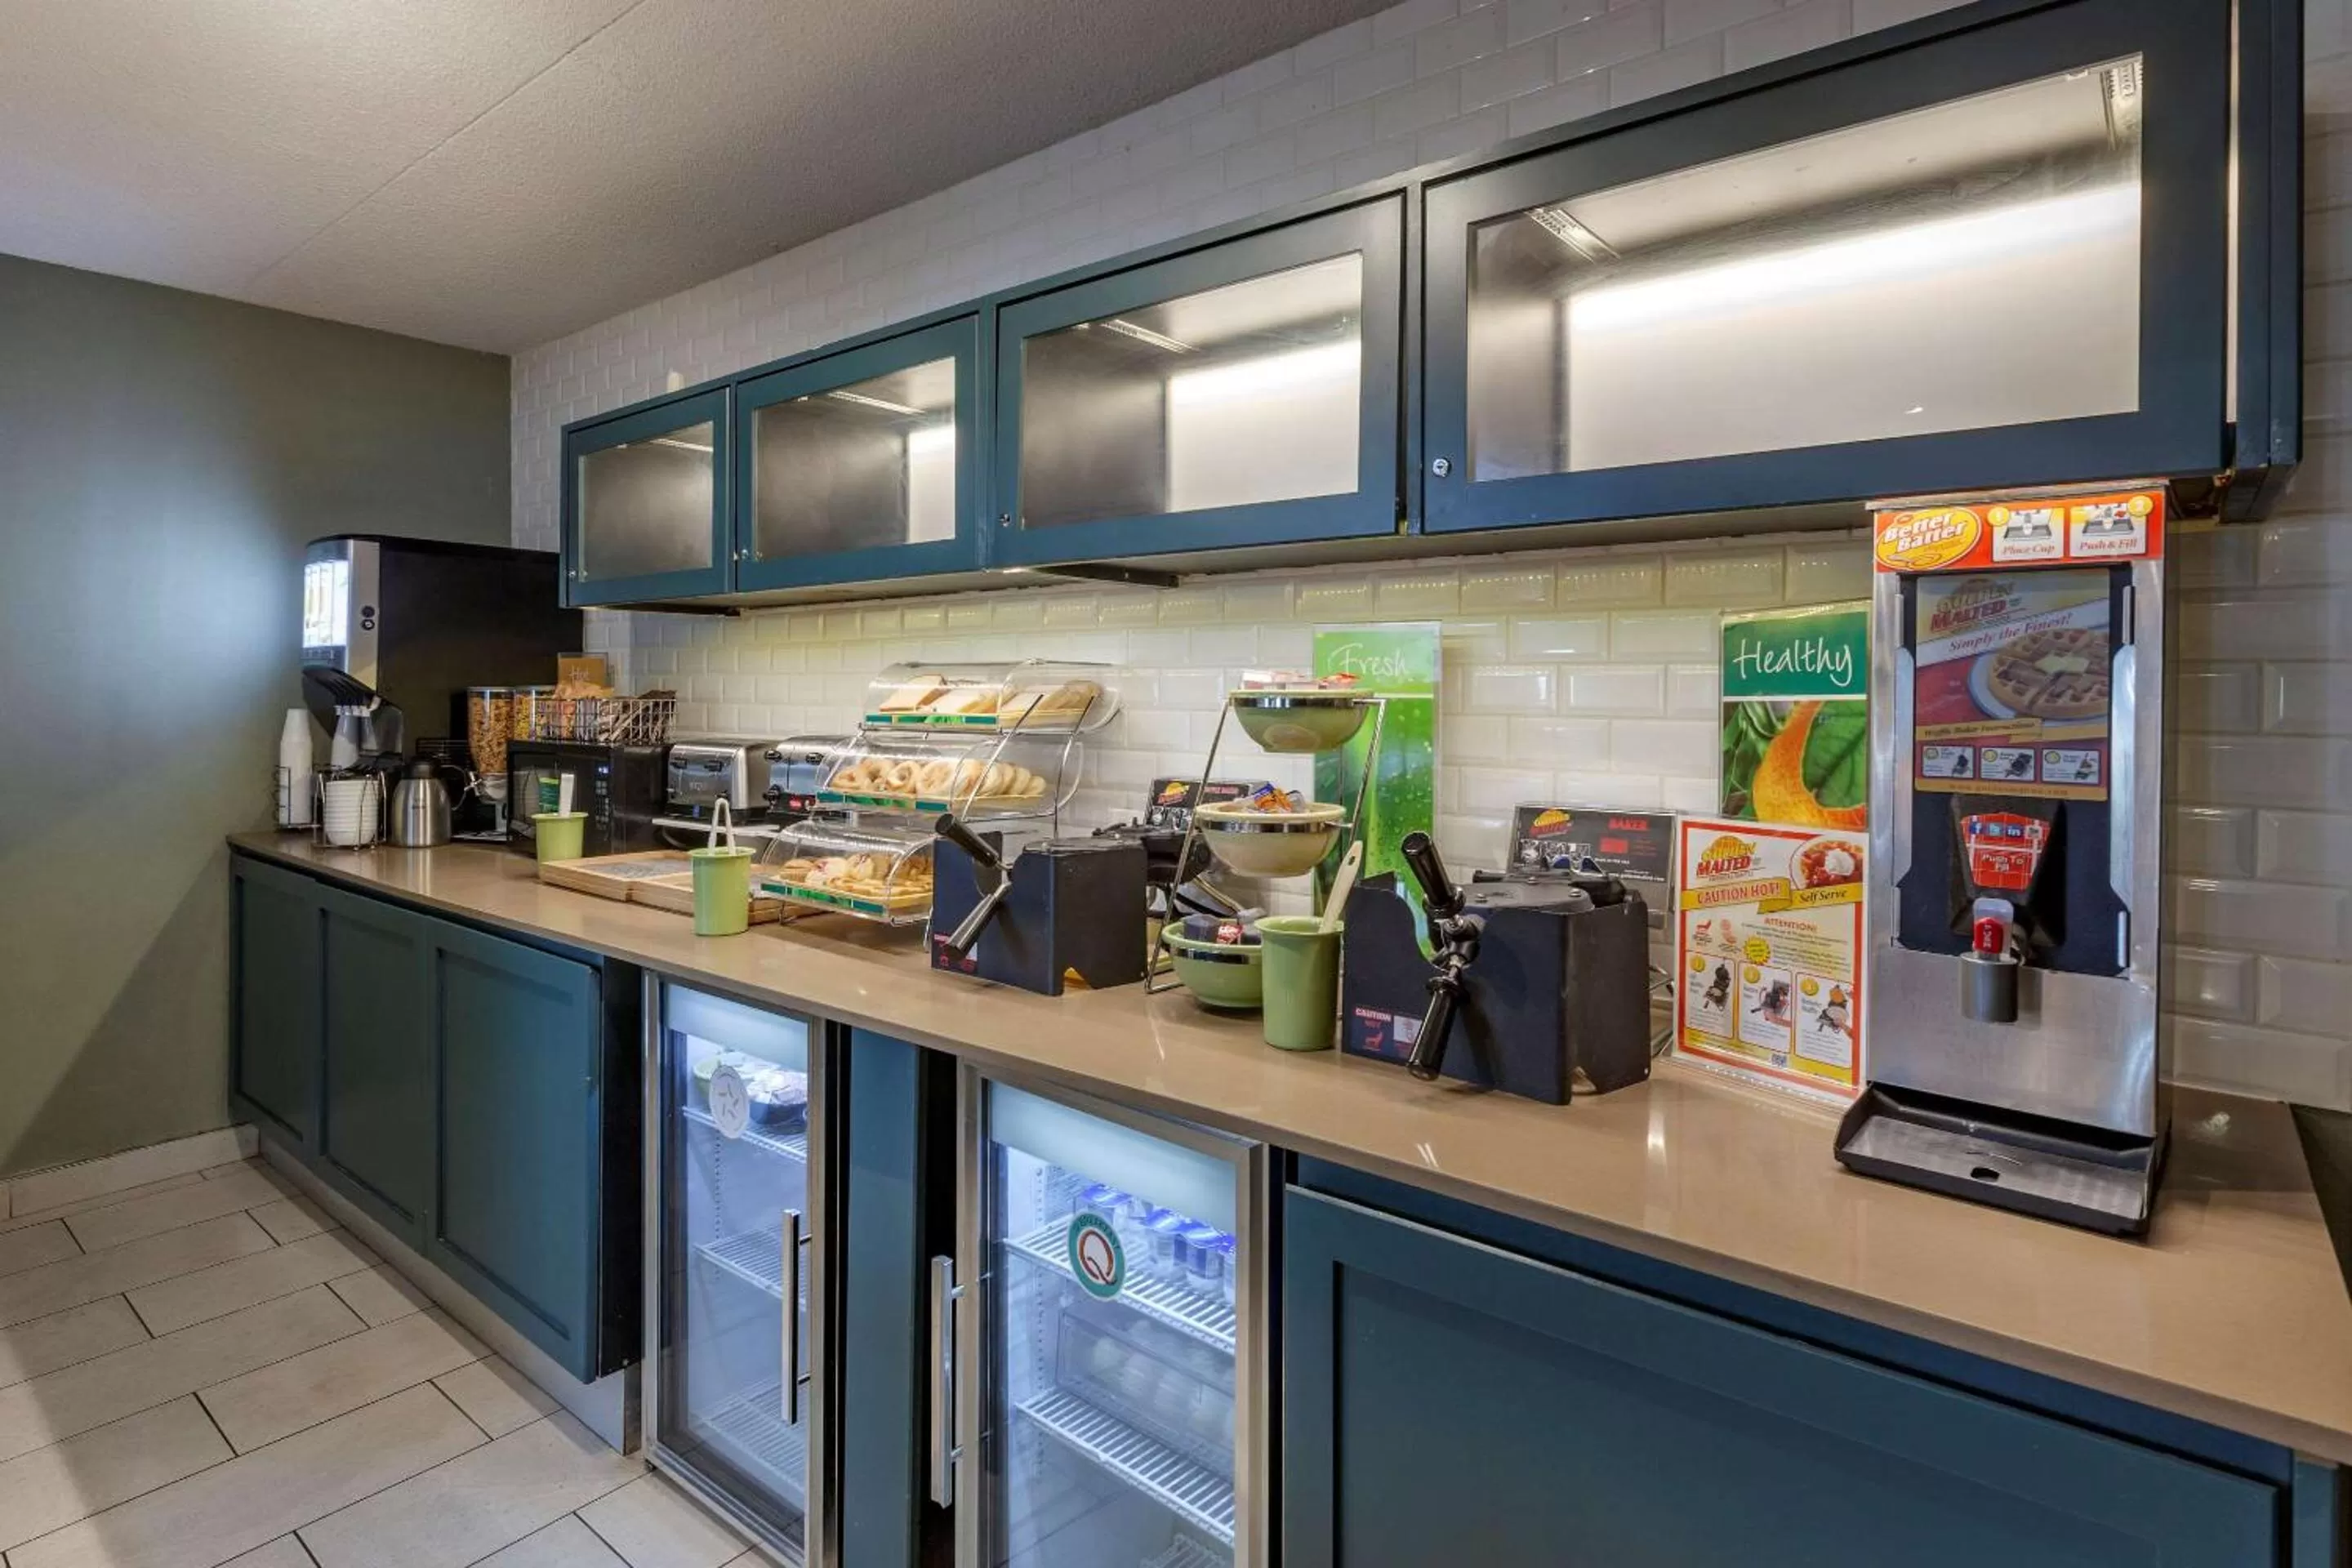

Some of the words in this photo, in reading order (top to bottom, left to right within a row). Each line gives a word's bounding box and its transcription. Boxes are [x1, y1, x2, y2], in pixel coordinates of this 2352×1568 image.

[1883, 512, 1953, 544] Better
[1896, 520, 1968, 553] Batter
[2002, 545, 2030, 556] Place
[2032, 543, 2055, 555] Cup
[2079, 540, 2107, 550] Push
[2108, 540, 2117, 549] &
[2118, 537, 2138, 550] Fill
[1949, 632, 1994, 653] Simply
[1998, 624, 2021, 640] the
[2025, 612, 2073, 635] Finest!
[1327, 642, 1410, 677] Fresh
[1733, 637, 1853, 687] Healthy
[1696, 855, 1752, 876] MALTED
[1981, 853, 2009, 864] Push
[1697, 888, 1750, 904] CAUTION
[1751, 882, 1781, 899] HOT!
[1799, 888, 1819, 904] Self
[1818, 889, 1848, 901] Serve
[1764, 916, 1818, 933] ATTENTION!
[1355, 1007, 1392, 1022] CAUTION
